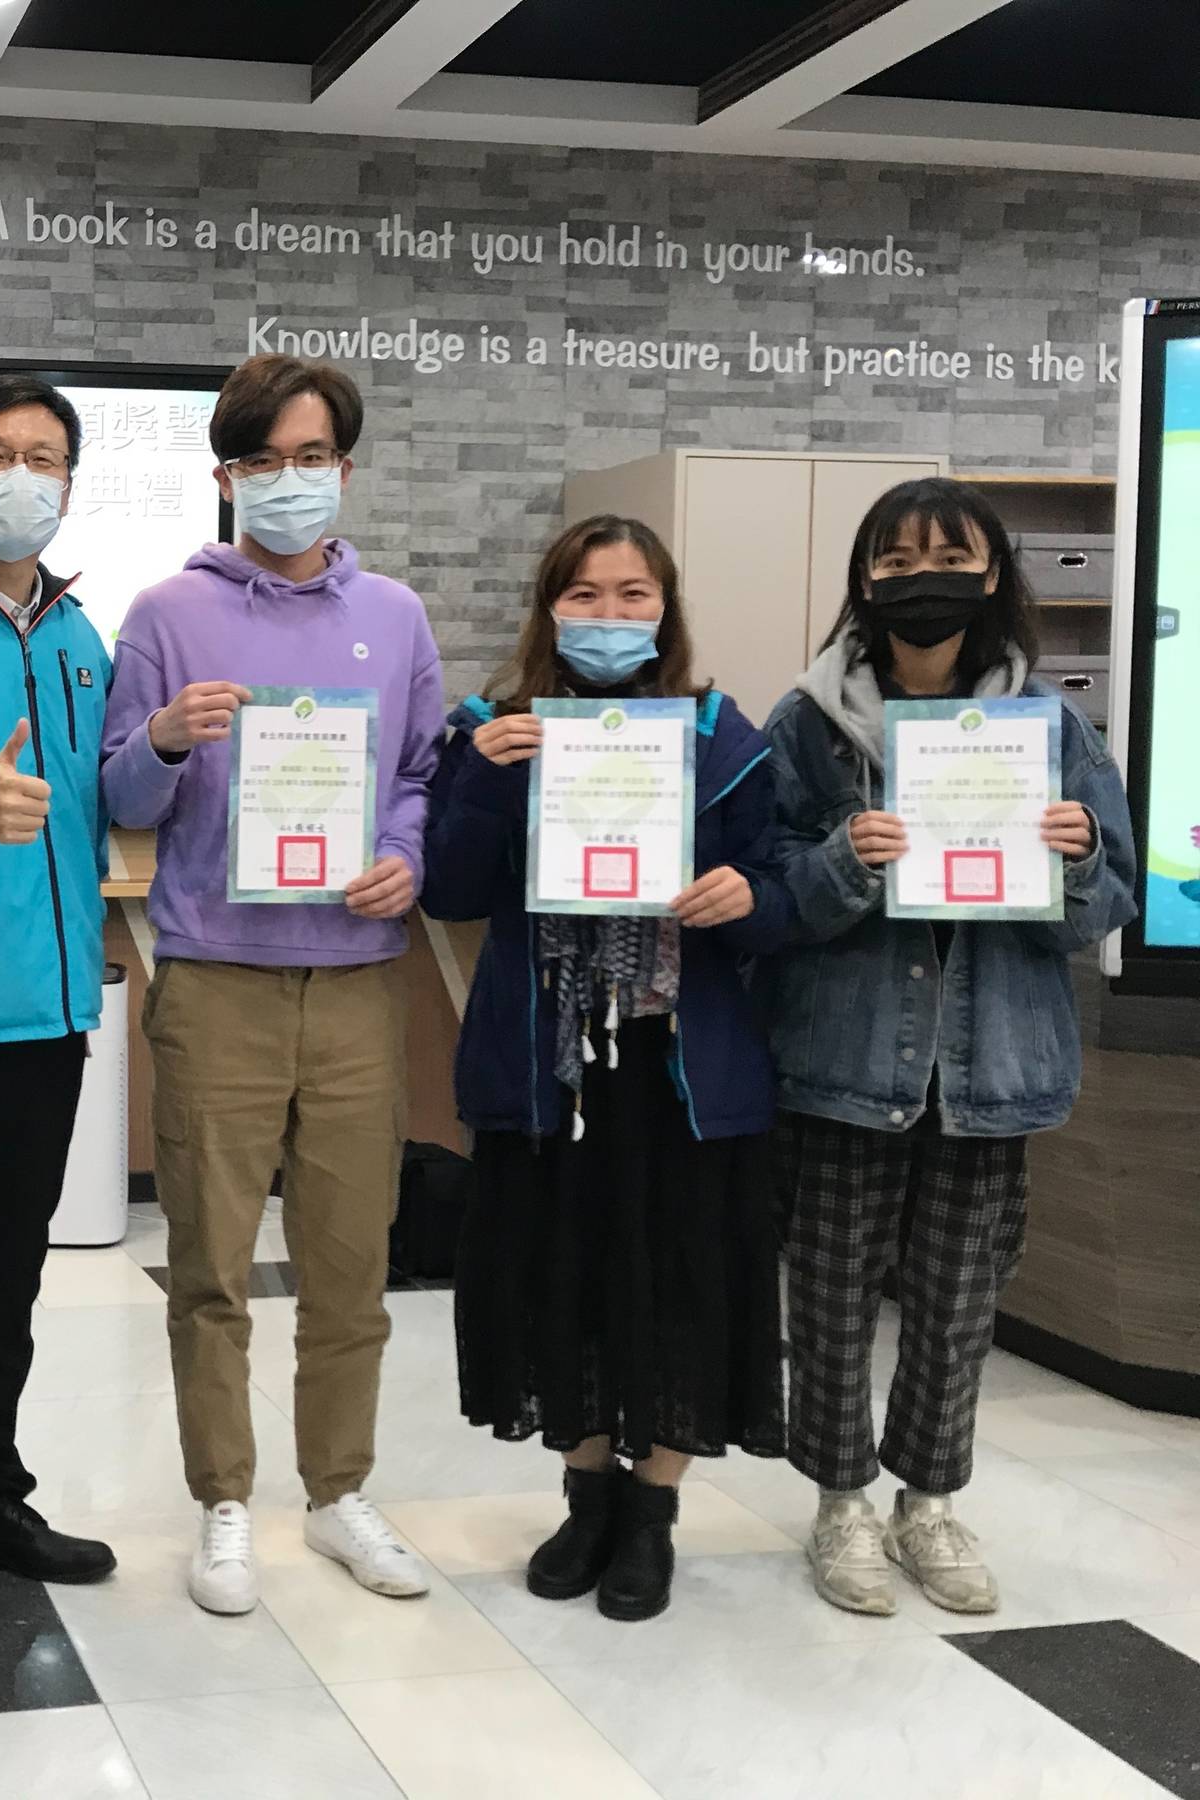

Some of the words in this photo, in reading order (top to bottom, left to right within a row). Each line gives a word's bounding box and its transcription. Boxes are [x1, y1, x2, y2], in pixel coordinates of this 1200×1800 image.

[25, 198, 129, 247] book
[145, 207, 178, 248] is
[195, 218, 217, 250] a
[234, 207, 361, 255] dream
[375, 213, 456, 260] that
[470, 230, 544, 275] you
[558, 222, 641, 269] hold
[655, 231, 688, 270] in
[703, 242, 790, 284] your
[803, 232, 926, 278] hands.
[246, 316, 466, 374] Knowledge
[479, 325, 512, 363] is
[525, 332, 548, 366] a
[562, 329, 731, 376] treasure,
[748, 331, 811, 374] but
[824, 340, 971, 387] practice
[985, 342, 1015, 380] is
[1028, 342, 1085, 383] the
